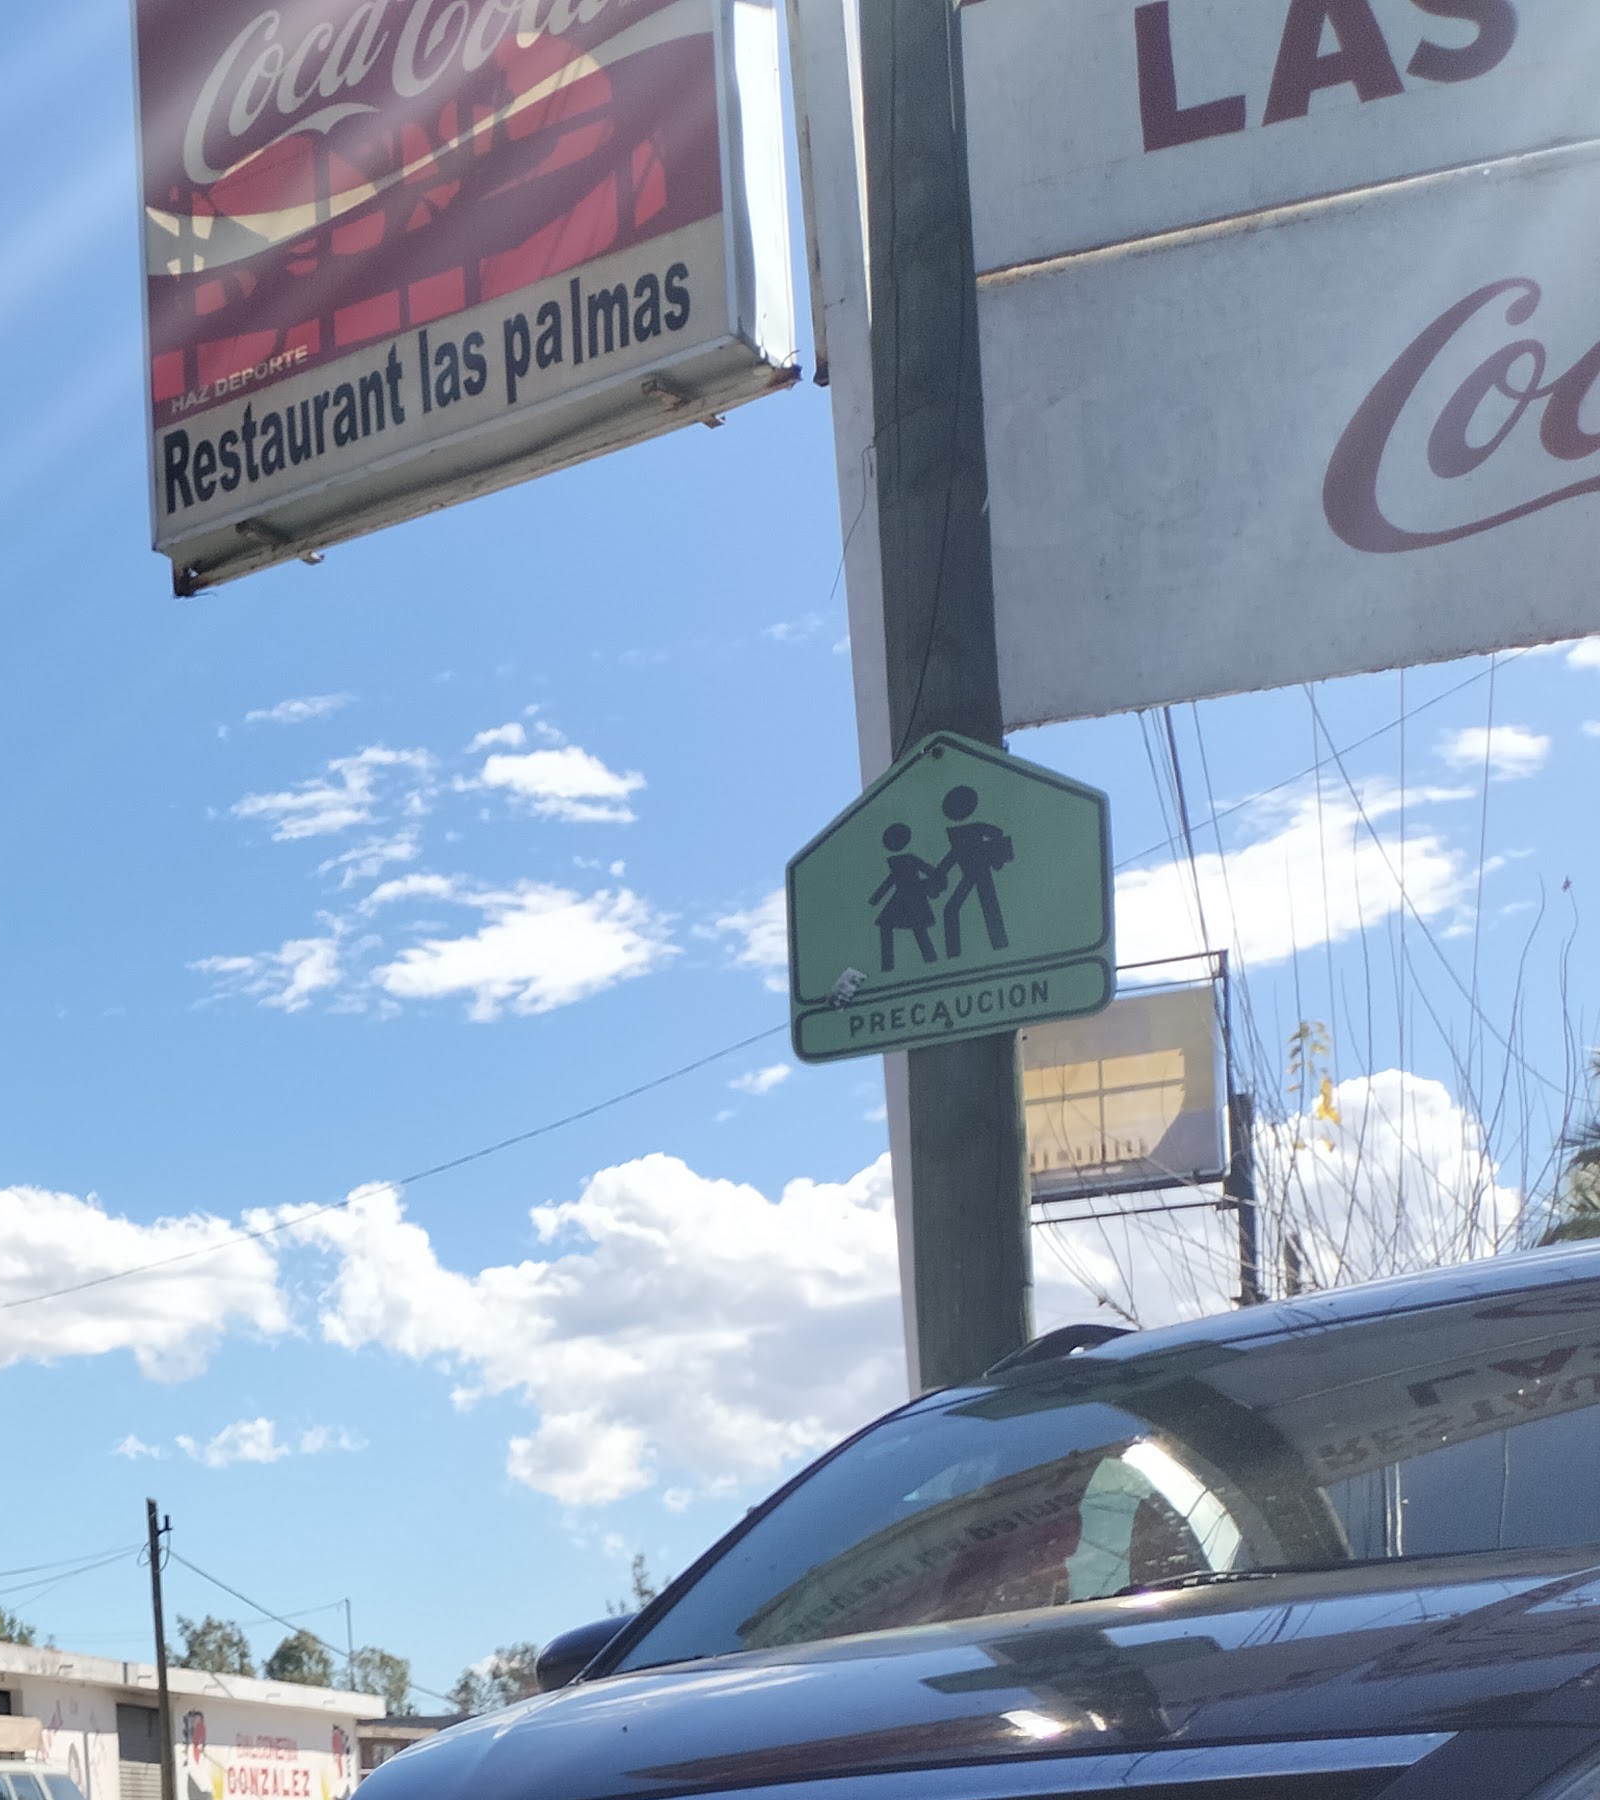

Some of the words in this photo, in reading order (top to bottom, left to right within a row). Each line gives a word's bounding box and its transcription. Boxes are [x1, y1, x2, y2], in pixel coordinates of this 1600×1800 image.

[1133, 0, 1521, 153] LAS
[163, 342, 407, 514] Restaurant
[418, 328, 488, 415] las
[503, 261, 691, 405] palmas
[171, 385, 211, 414] HAZ
[214, 344, 309, 397] DEPORTE
[848, 979, 1050, 1039] PRECAUCION
[227, 1766, 311, 1797] GONZALEZ
